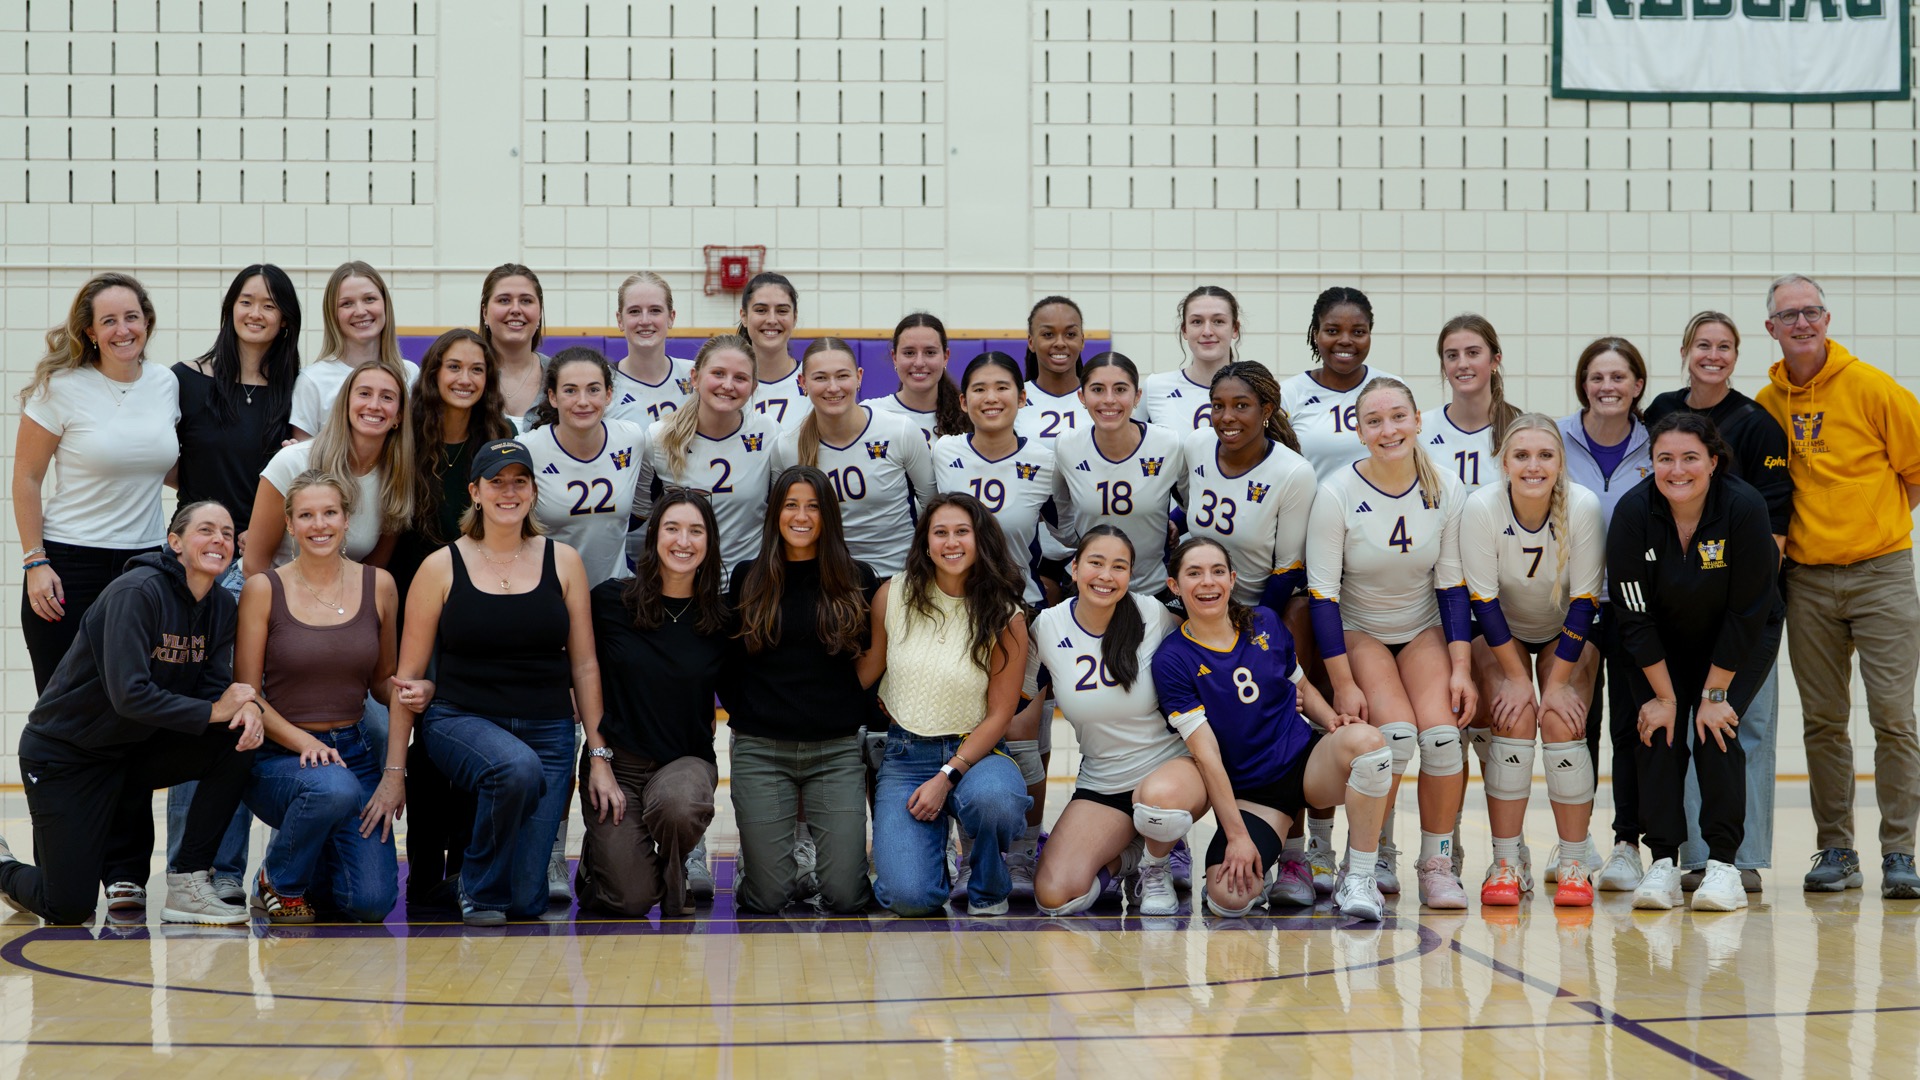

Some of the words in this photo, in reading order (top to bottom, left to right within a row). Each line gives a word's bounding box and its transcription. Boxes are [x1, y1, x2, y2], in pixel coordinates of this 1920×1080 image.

[755, 398, 789, 424] 17
[1039, 410, 1076, 439] 21
[1193, 403, 1214, 430] 6
[1329, 404, 1357, 433] 16
[710, 458, 734, 494] 2
[828, 465, 866, 503] 10
[1454, 450, 1481, 486] 11
[567, 478, 616, 516] 22
[970, 478, 1005, 514] 19
[1097, 480, 1134, 516] 18
[1195, 489, 1237, 536] 33
[1389, 515, 1413, 554] 4
[1522, 546, 1544, 578] 7
[1075, 654, 1121, 692] 20
[1232, 666, 1260, 704] 8
